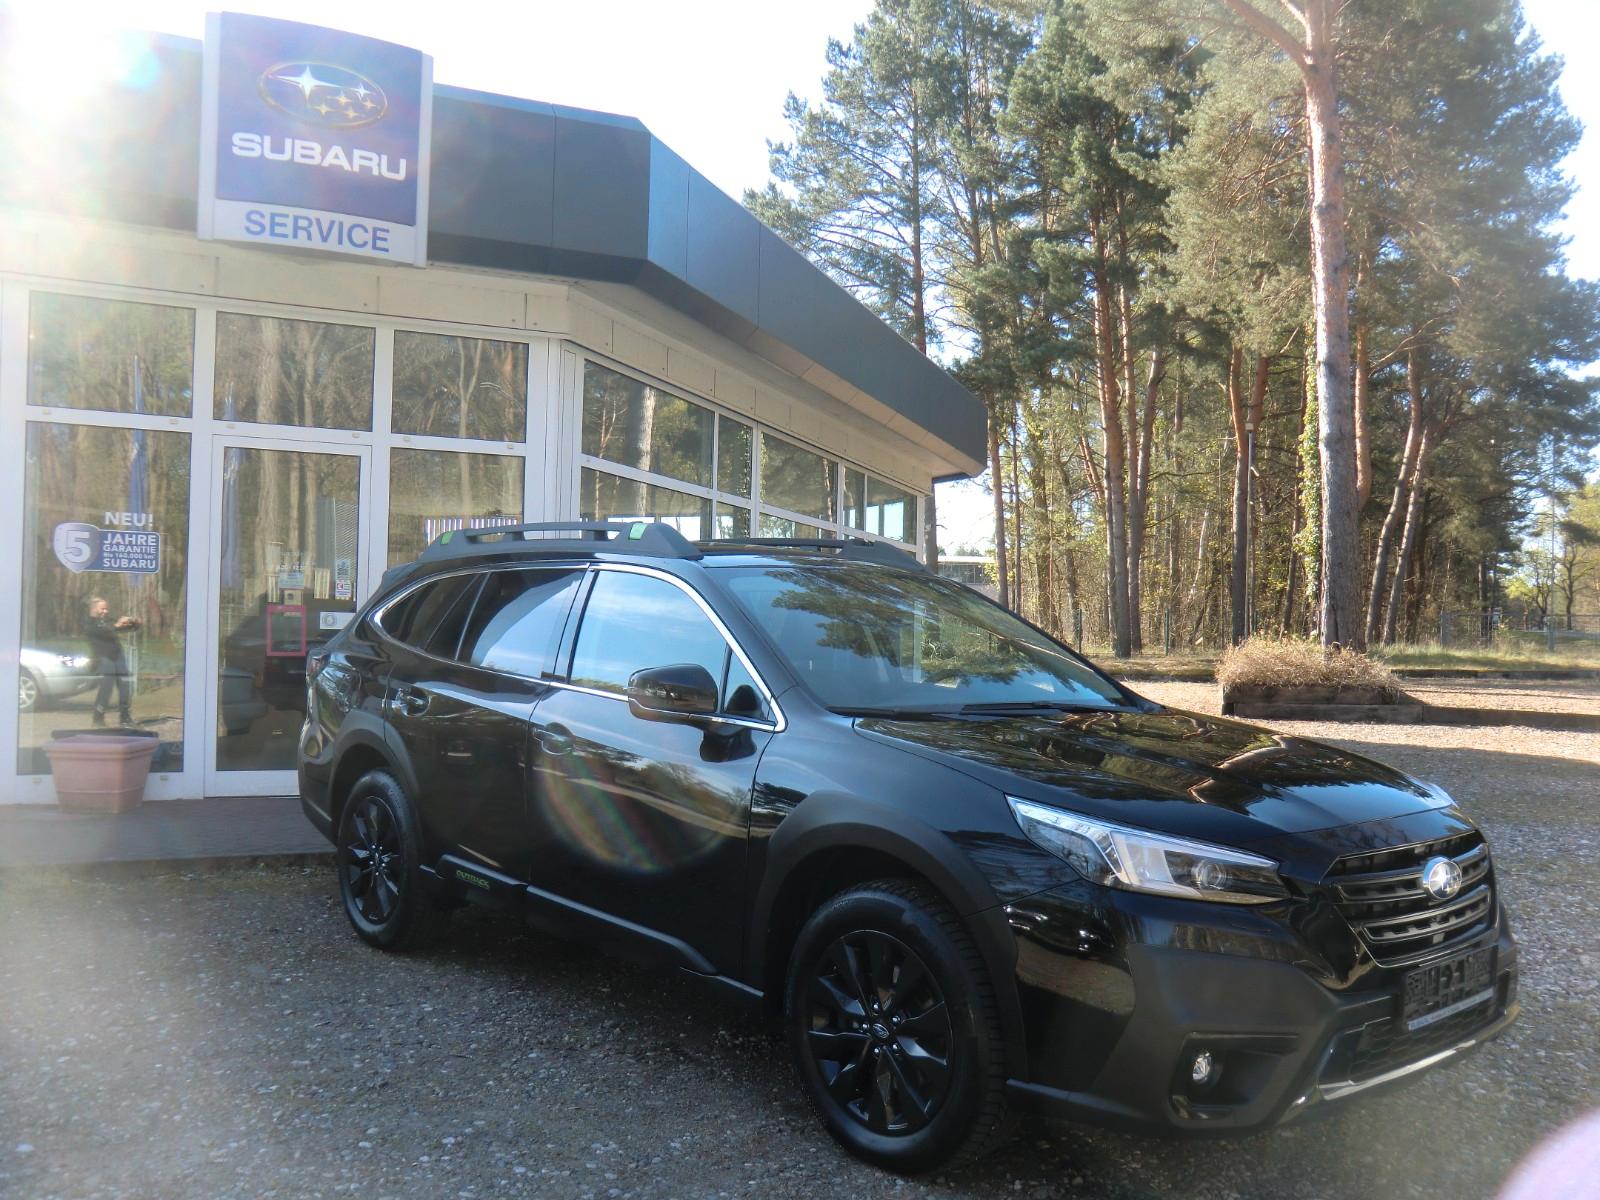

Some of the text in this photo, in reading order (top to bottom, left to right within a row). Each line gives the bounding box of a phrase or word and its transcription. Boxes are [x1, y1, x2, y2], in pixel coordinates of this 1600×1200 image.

[231, 132, 406, 181] SUBARU
[245, 210, 390, 253] SERVICE
[104, 511, 154, 527] NEU!
[65, 531, 91, 563] 5
[103, 533, 157, 545] JAHRE
[103, 544, 157, 554] GARANTIE
[103, 558, 156, 569] SUBARU
